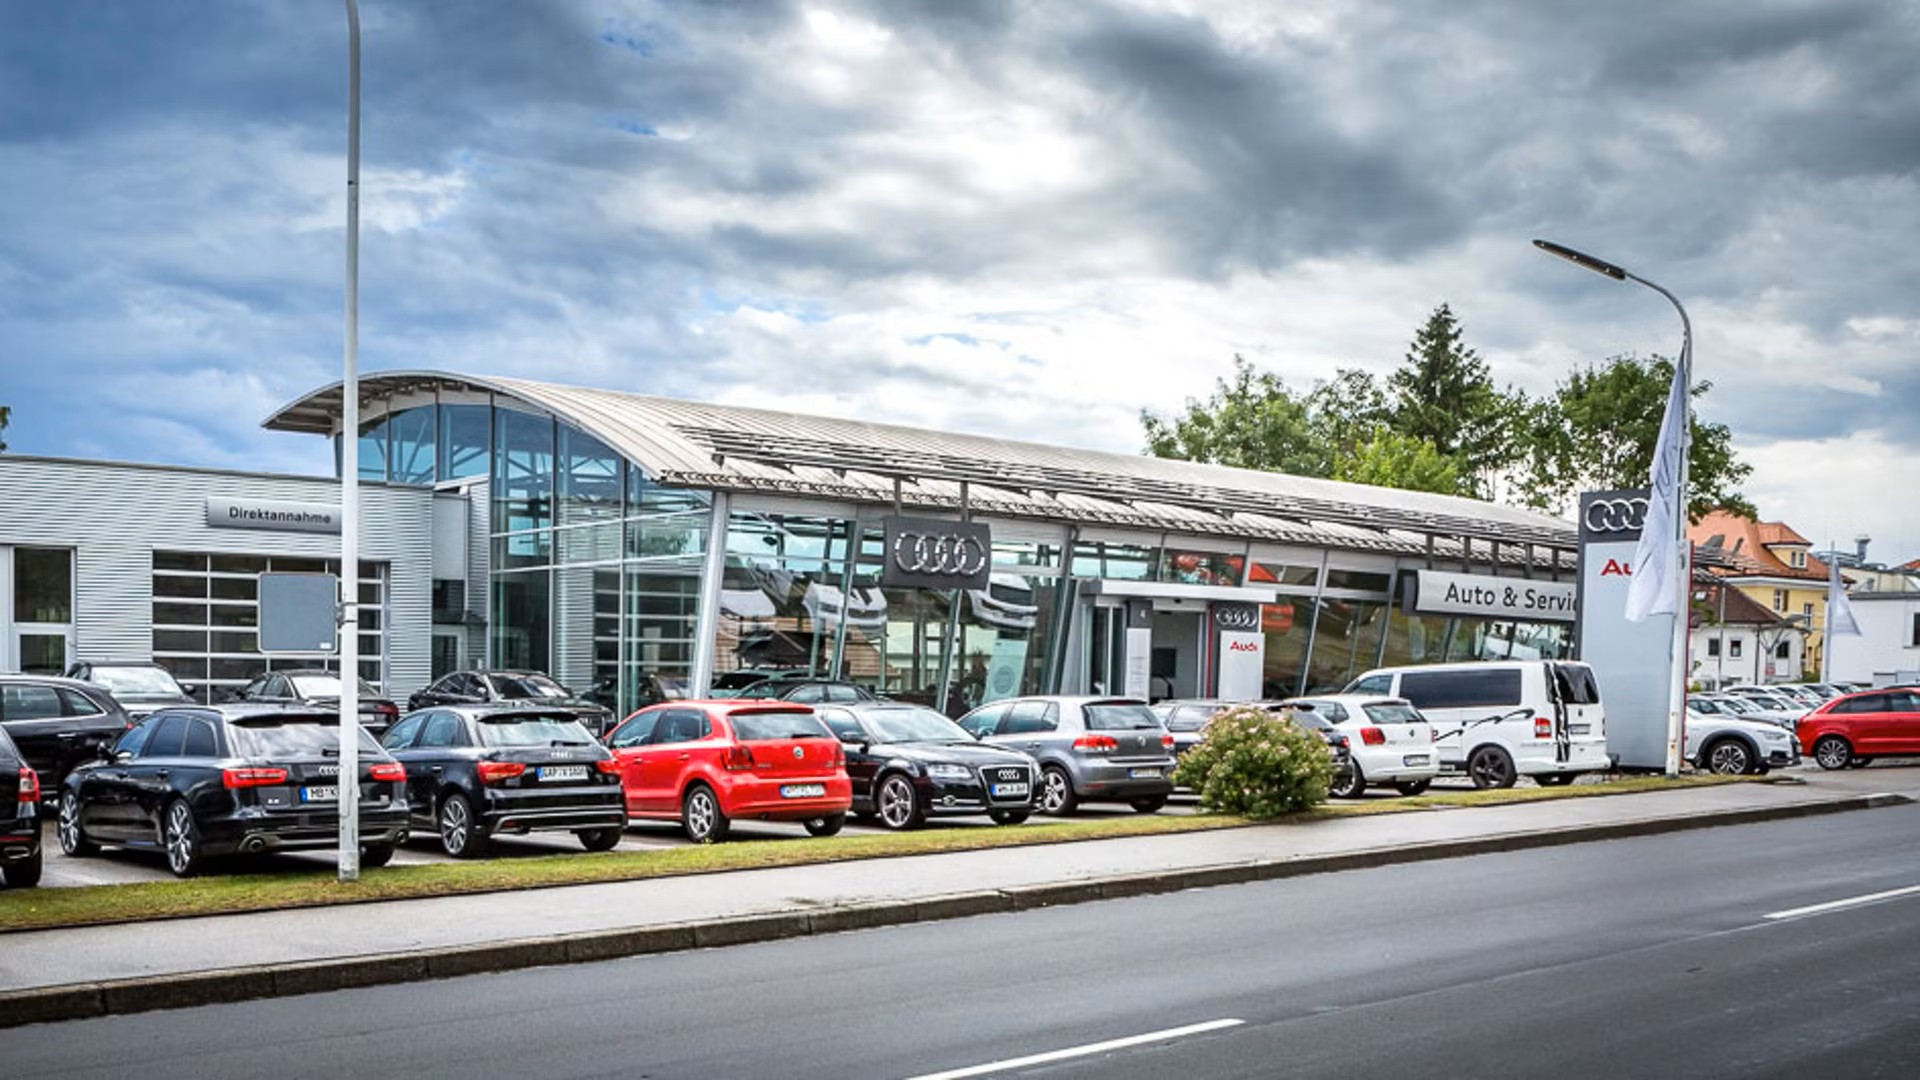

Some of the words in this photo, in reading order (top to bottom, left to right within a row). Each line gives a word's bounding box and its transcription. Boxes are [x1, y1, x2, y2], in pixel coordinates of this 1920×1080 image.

[229, 506, 331, 523] Direktannahme
[1600, 558, 1633, 577] Au
[1444, 581, 1496, 606] Auto
[1502, 586, 1519, 607] &
[1524, 588, 1577, 612] Servi
[1230, 640, 1258, 652] Audi
